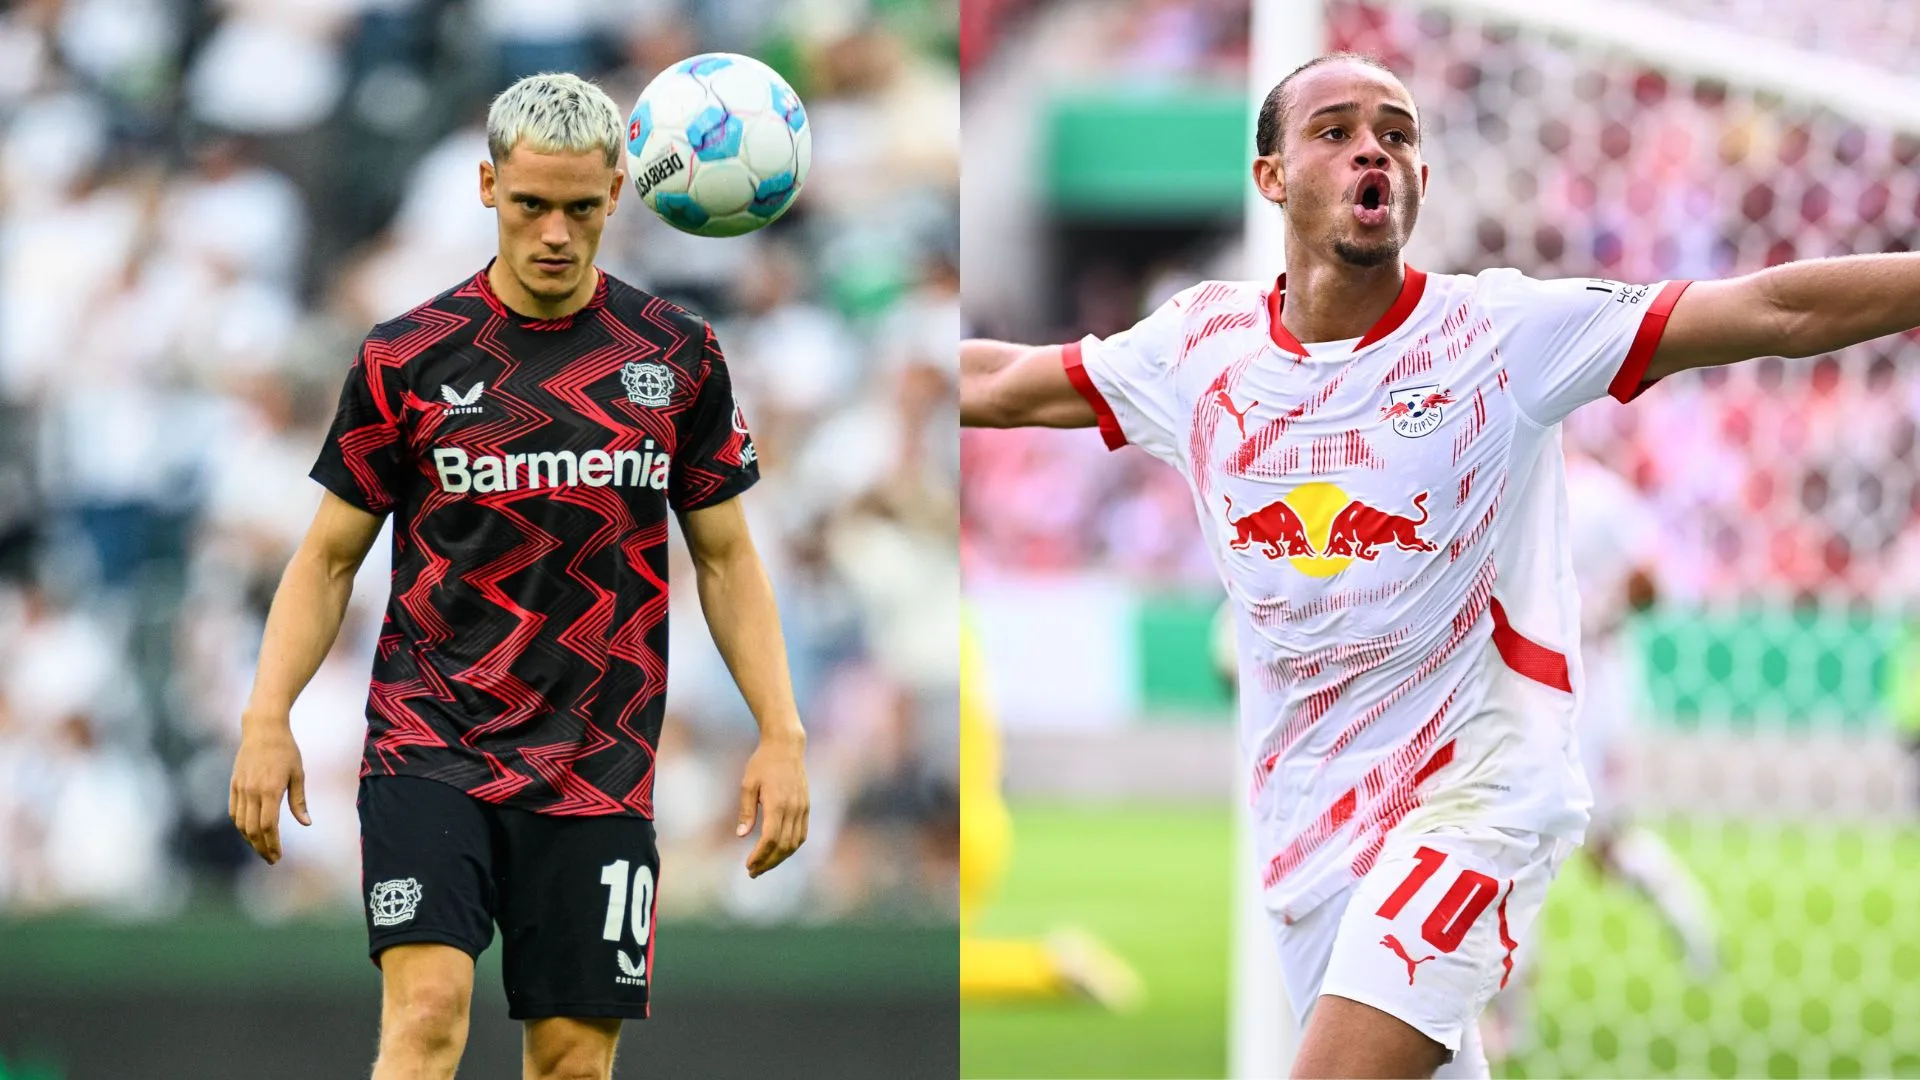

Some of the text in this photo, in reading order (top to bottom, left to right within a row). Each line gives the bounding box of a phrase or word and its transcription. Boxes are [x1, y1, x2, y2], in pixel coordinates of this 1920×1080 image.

[443, 406, 483, 416] CASTORE
[1409, 412, 1439, 433] LEIPZIG
[434, 440, 670, 493] Barmenia
[600, 859, 654, 946] 10
[1375, 846, 1499, 954] 10
